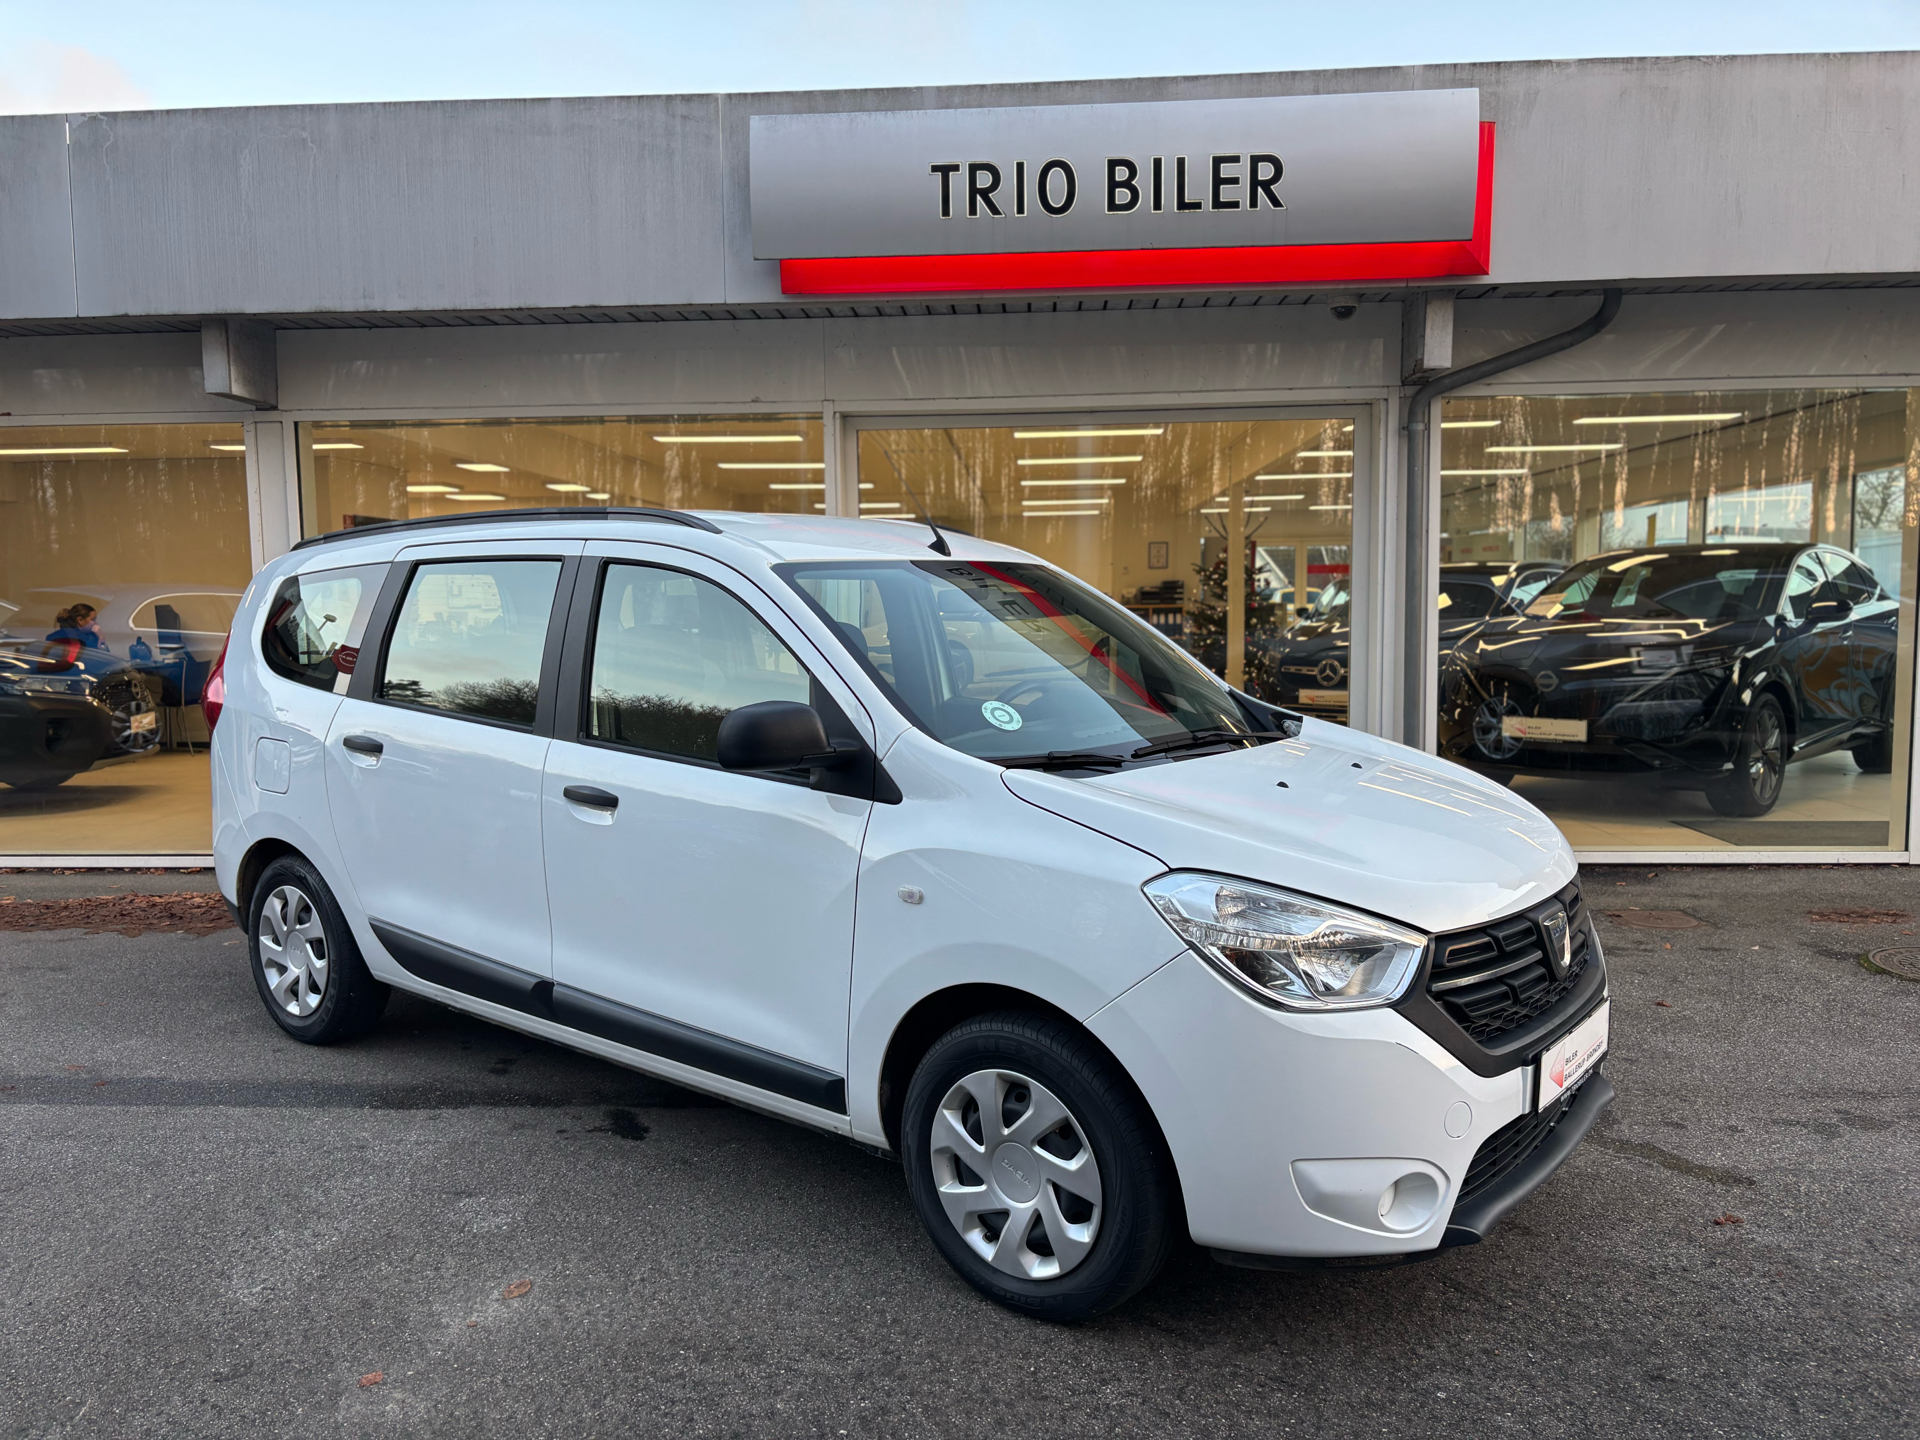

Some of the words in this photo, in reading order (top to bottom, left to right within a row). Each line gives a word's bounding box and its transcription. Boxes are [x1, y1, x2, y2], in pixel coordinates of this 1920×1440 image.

[929, 157, 1078, 219] TRIO
[1105, 152, 1287, 214] BILER
[977, 1038, 1085, 1098] NEXEN
[1564, 1058, 1586, 1082] BALLERUP
[1565, 1050, 1578, 1066] BILER
